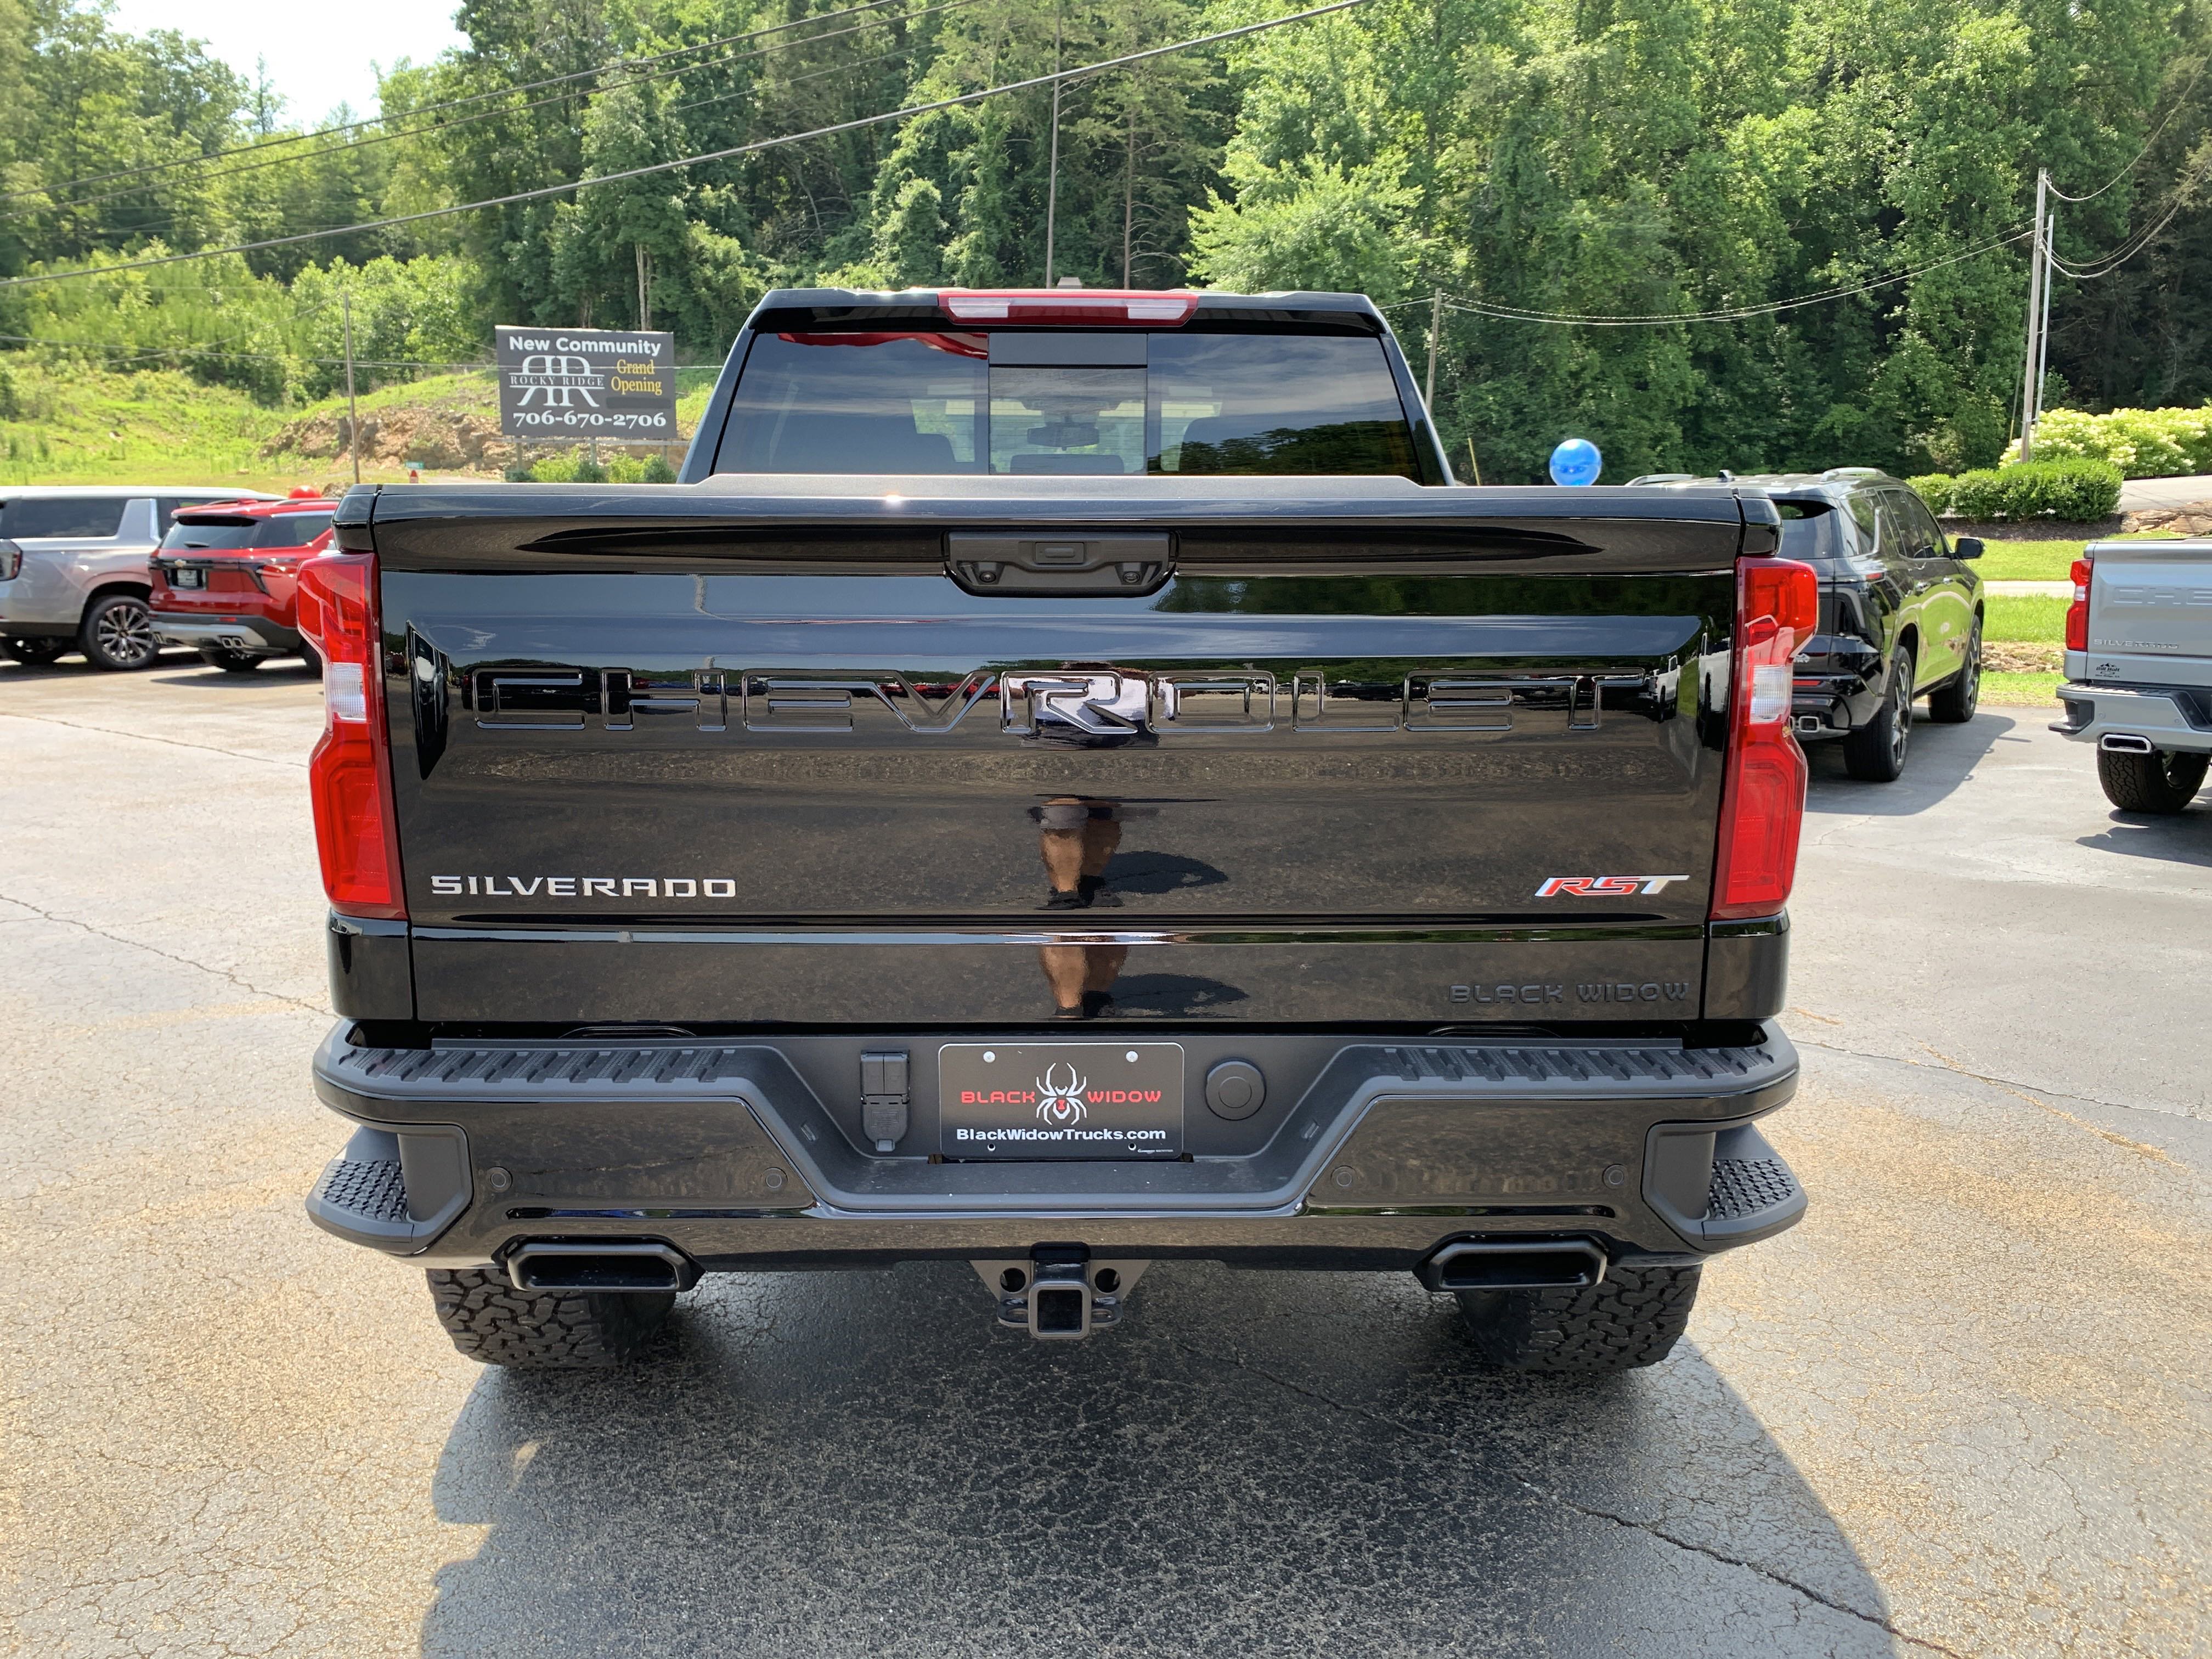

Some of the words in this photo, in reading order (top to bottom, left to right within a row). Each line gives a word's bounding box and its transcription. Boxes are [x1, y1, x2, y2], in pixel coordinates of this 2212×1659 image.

[509, 336, 550, 351] New
[556, 337, 661, 357] Community
[616, 359, 655, 375] Grand
[510, 375, 556, 385] ROCKY
[563, 377, 604, 386] RIDGE
[611, 376, 663, 395] Opening
[513, 410, 667, 429] 706-670-2706
[2093, 639, 2179, 650] SILVERADO
[471, 667, 1646, 734] CHEVROLET
[430, 875, 737, 898] SILVERADO
[1534, 874, 1690, 897] RST
[1449, 984, 1564, 1003] BLACK
[1576, 982, 1690, 1003] WIDOW
[961, 1091, 1036, 1104] BLACK
[1087, 1090, 1162, 1103] WIDOW
[956, 1128, 1166, 1141] BlackWidowTrucks.com
